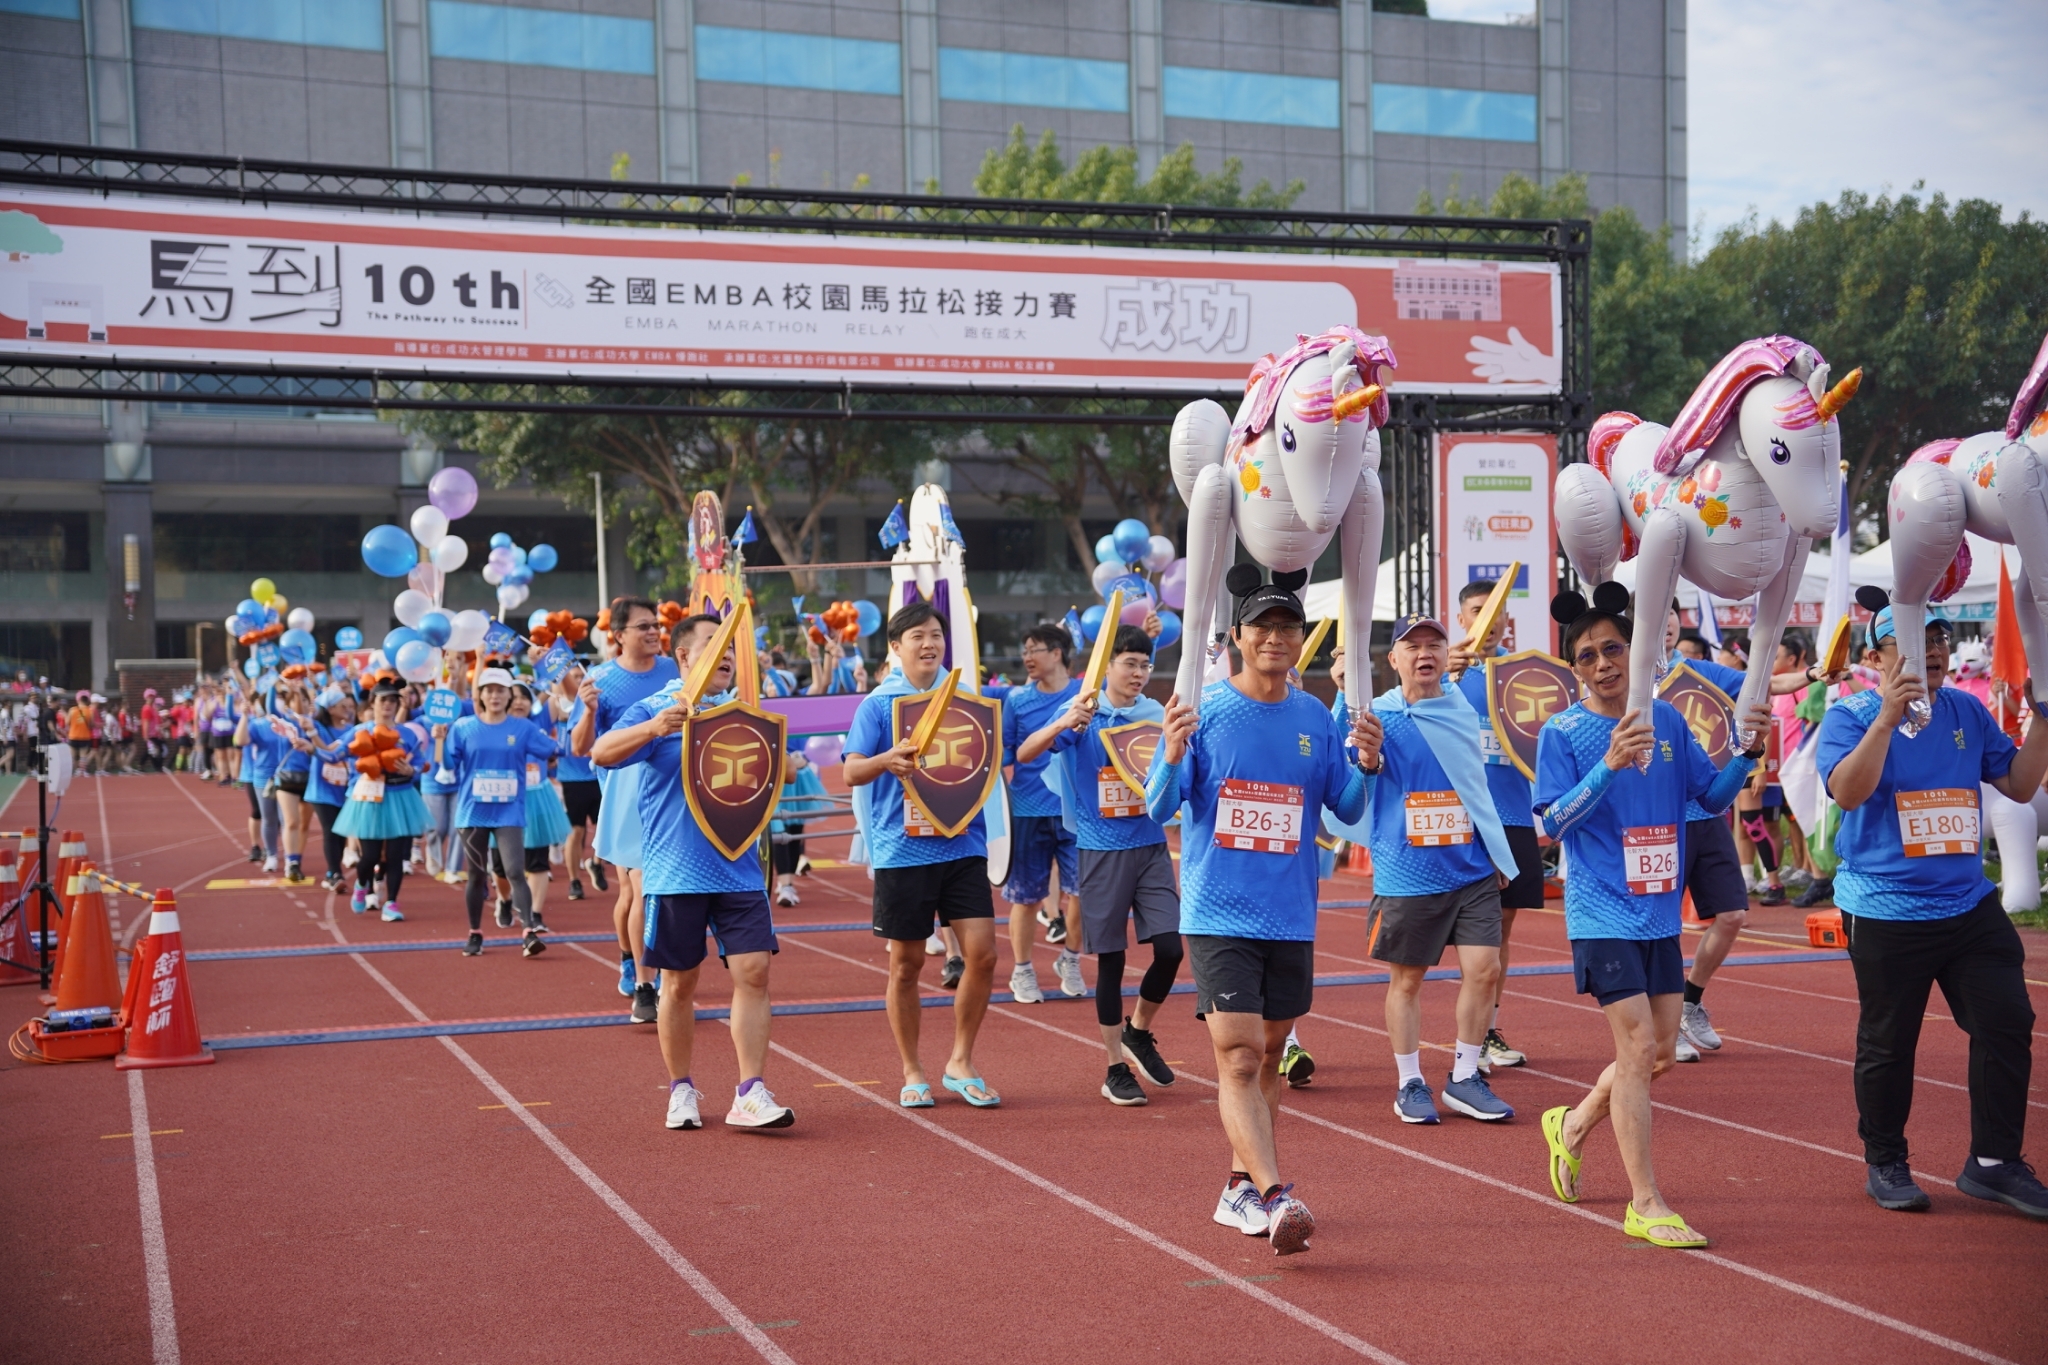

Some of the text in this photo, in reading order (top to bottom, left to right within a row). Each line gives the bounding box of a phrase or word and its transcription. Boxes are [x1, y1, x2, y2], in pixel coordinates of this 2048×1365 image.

[139, 239, 342, 328] 馬到
[585, 275, 1077, 321] 全國EMBA校園馬拉松接力賽
[367, 311, 519, 326] The Pathway to Success
[624, 316, 679, 330] EMBA
[707, 319, 818, 334] MARATHON
[845, 323, 906, 337] RELAY
[1099, 278, 1252, 354] 成功
[1104, 786, 1142, 803] E17
[1246, 782, 1270, 792] 10th
[1553, 786, 1592, 826] RUNNING
[1230, 808, 1293, 834] B26-3
[1413, 811, 1471, 830] E178-4
[1908, 814, 1979, 838] E180-3
